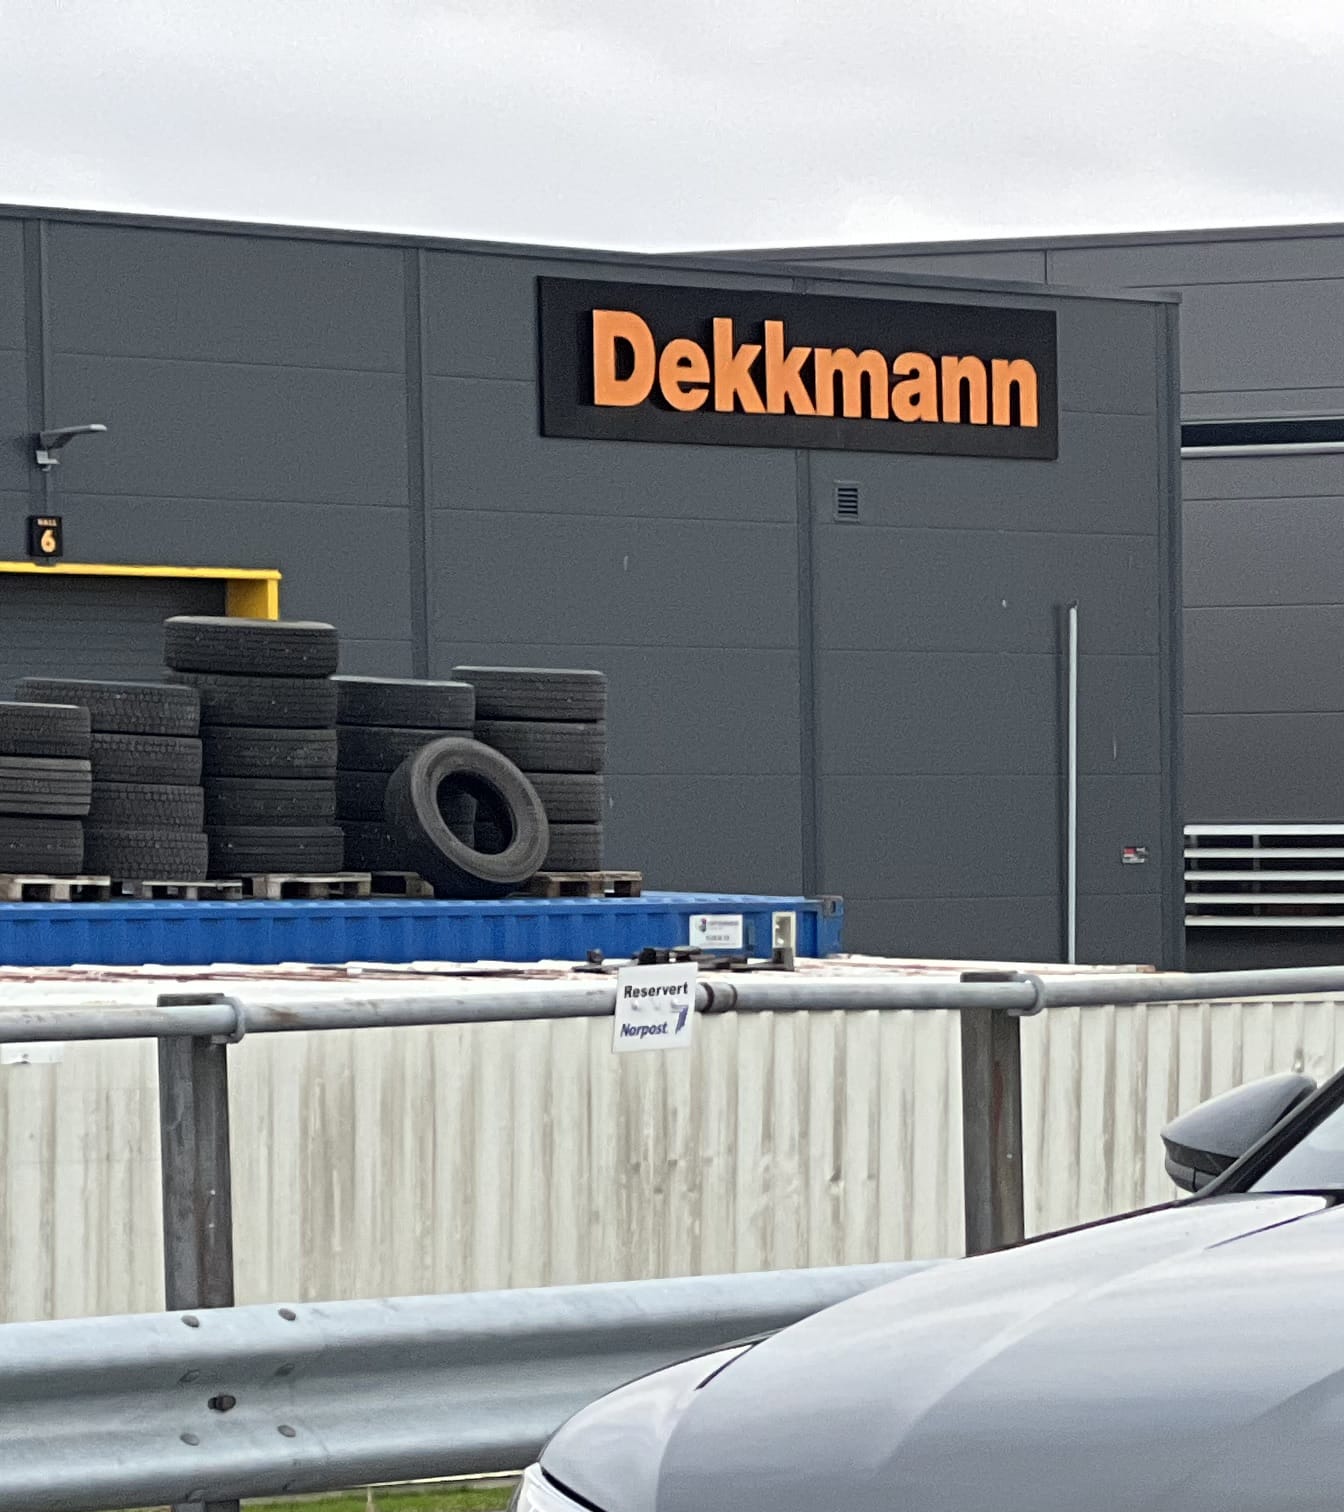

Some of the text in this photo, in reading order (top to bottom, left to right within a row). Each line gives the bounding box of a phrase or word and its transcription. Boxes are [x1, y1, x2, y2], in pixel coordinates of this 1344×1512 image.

[592, 309, 1038, 428] Dekkmann
[41, 529, 56, 552] 6
[624, 981, 688, 999] Reservert
[620, 1022, 668, 1039] Norpost
